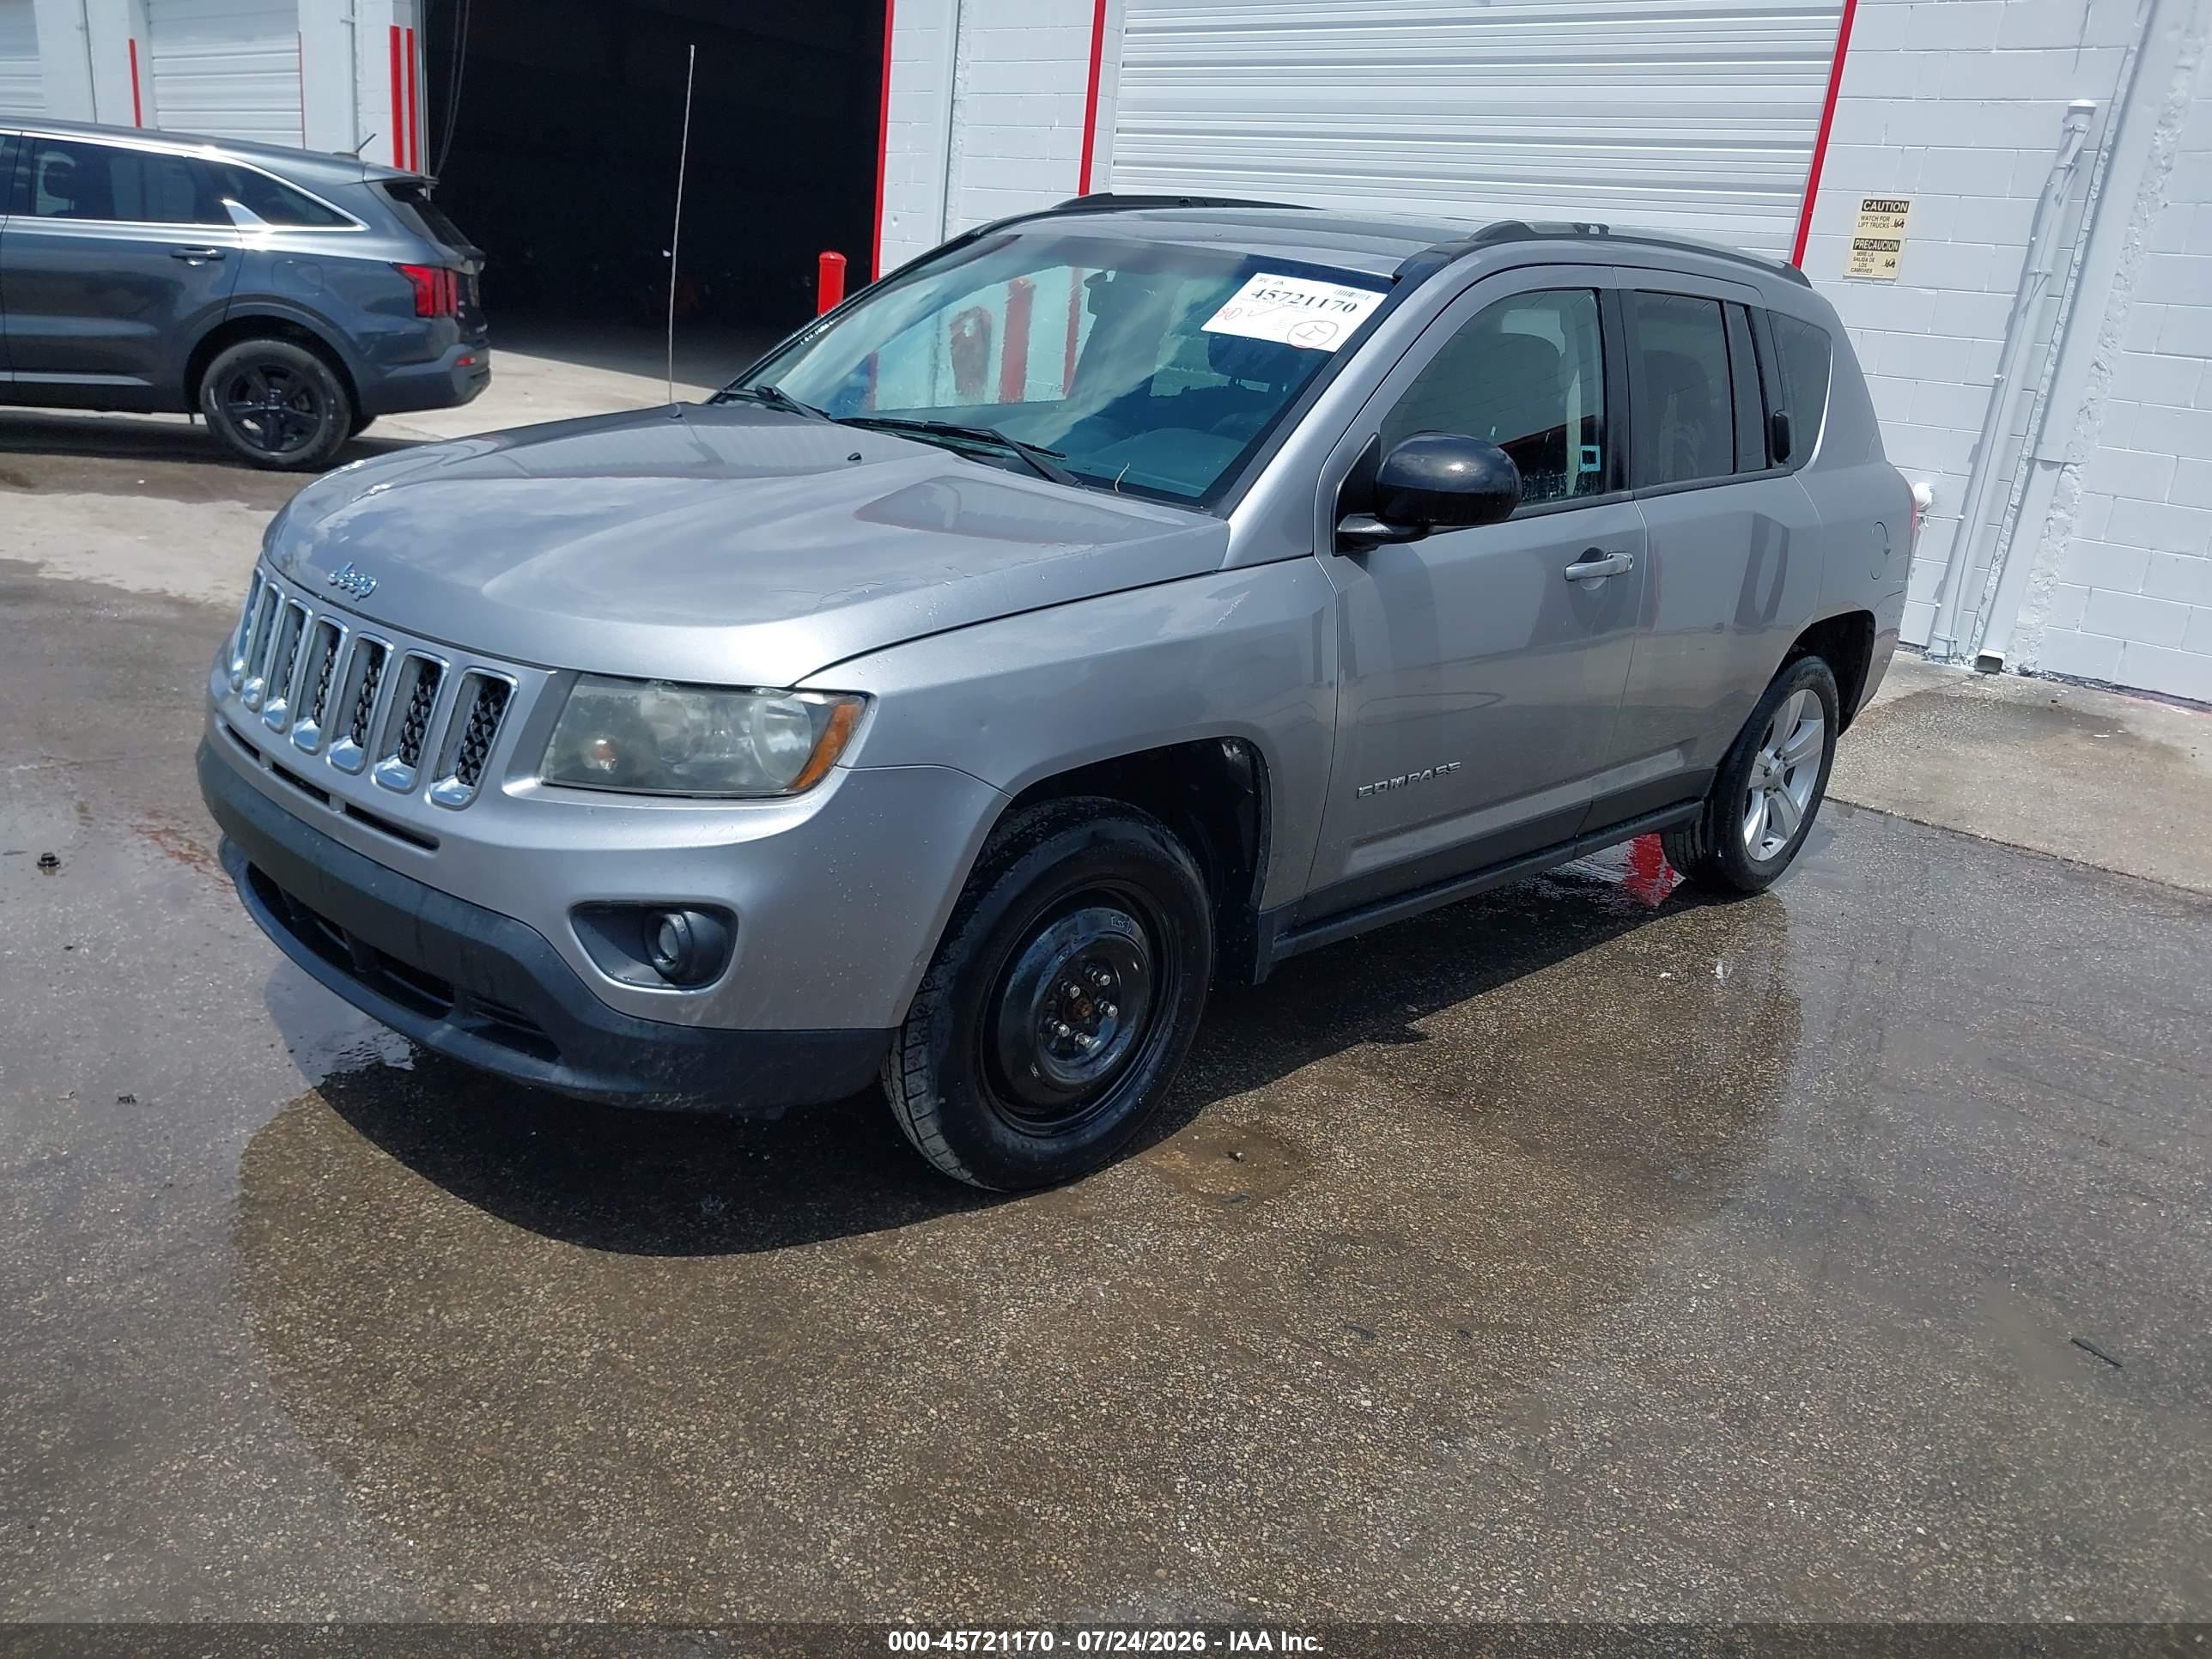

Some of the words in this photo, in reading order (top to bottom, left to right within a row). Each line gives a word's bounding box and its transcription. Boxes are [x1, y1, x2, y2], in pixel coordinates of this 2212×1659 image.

[1863, 201, 1908, 212] CAUTION
[1855, 240, 1899, 251] PRECAUCION
[1250, 288, 1358, 314] 45721170
[327, 561, 379, 602] Jeep
[1357, 761, 1462, 799] COMPASS
